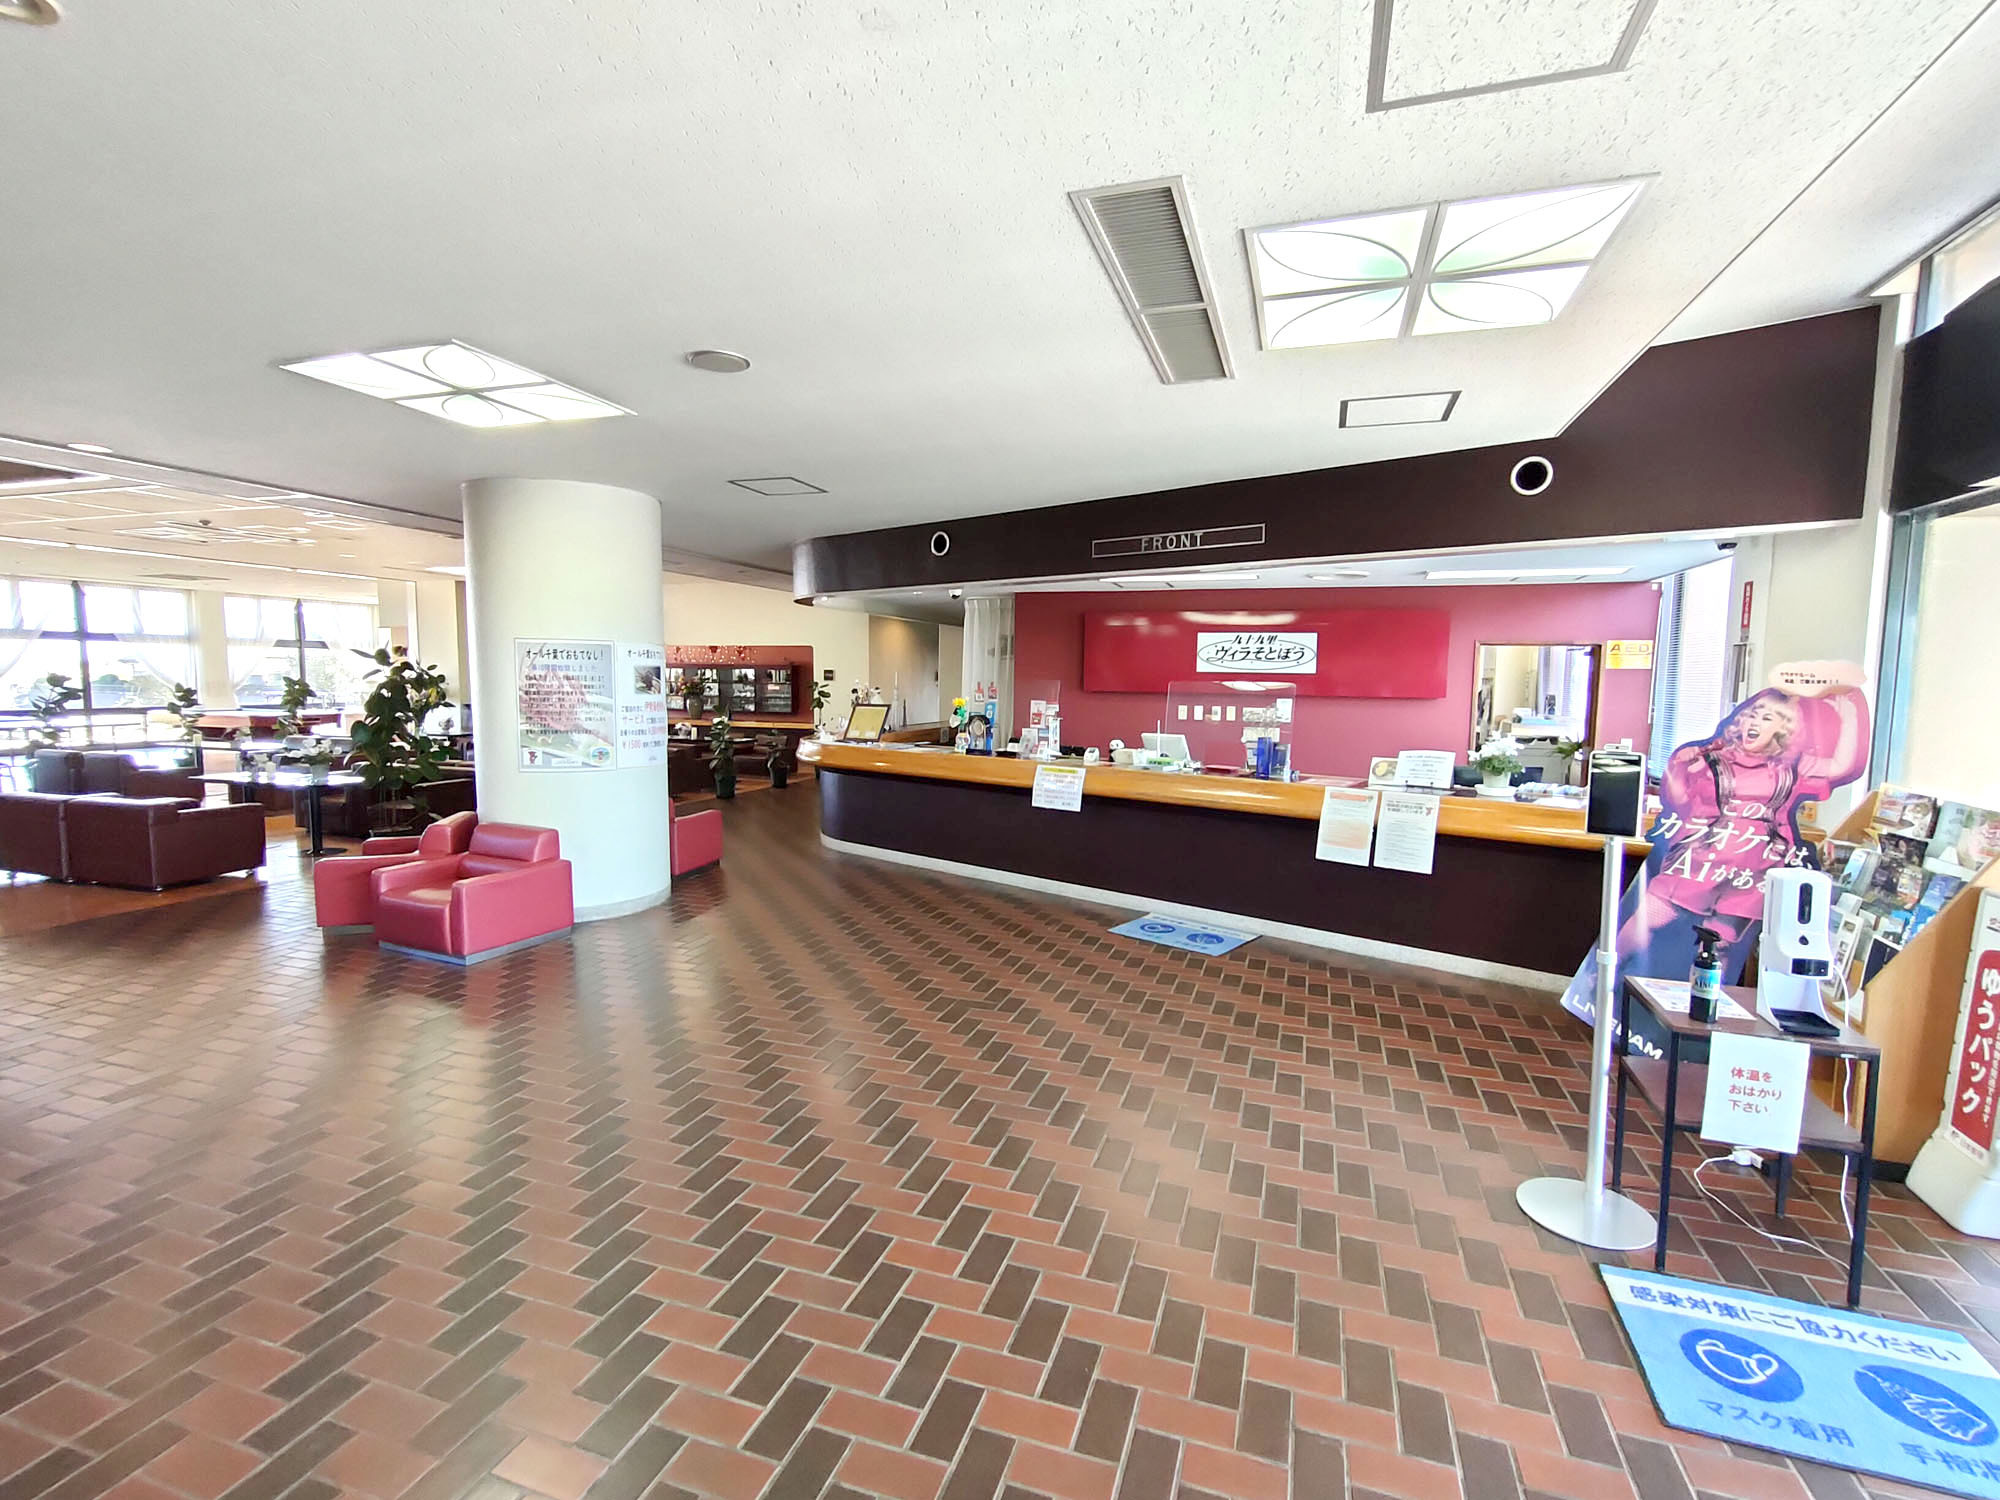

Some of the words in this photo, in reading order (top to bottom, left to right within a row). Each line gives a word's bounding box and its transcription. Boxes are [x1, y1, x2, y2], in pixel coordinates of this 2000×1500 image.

[1141, 532, 1203, 552] FRONT
[1214, 645, 1305, 661] ヴィラそとぼう
[1723, 798, 1767, 819] この
[1651, 812, 1813, 871] カラオケには、
[1961, 967, 2000, 1114] ゆうパック
[1731, 1066, 1773, 1083] 体温を
[1729, 1083, 1782, 1101] おはかり
[1728, 1099, 1768, 1114] 下さい
[1629, 1284, 1961, 1362] 感染対策にご協力ください
[1697, 1398, 1856, 1448] マスク着用
